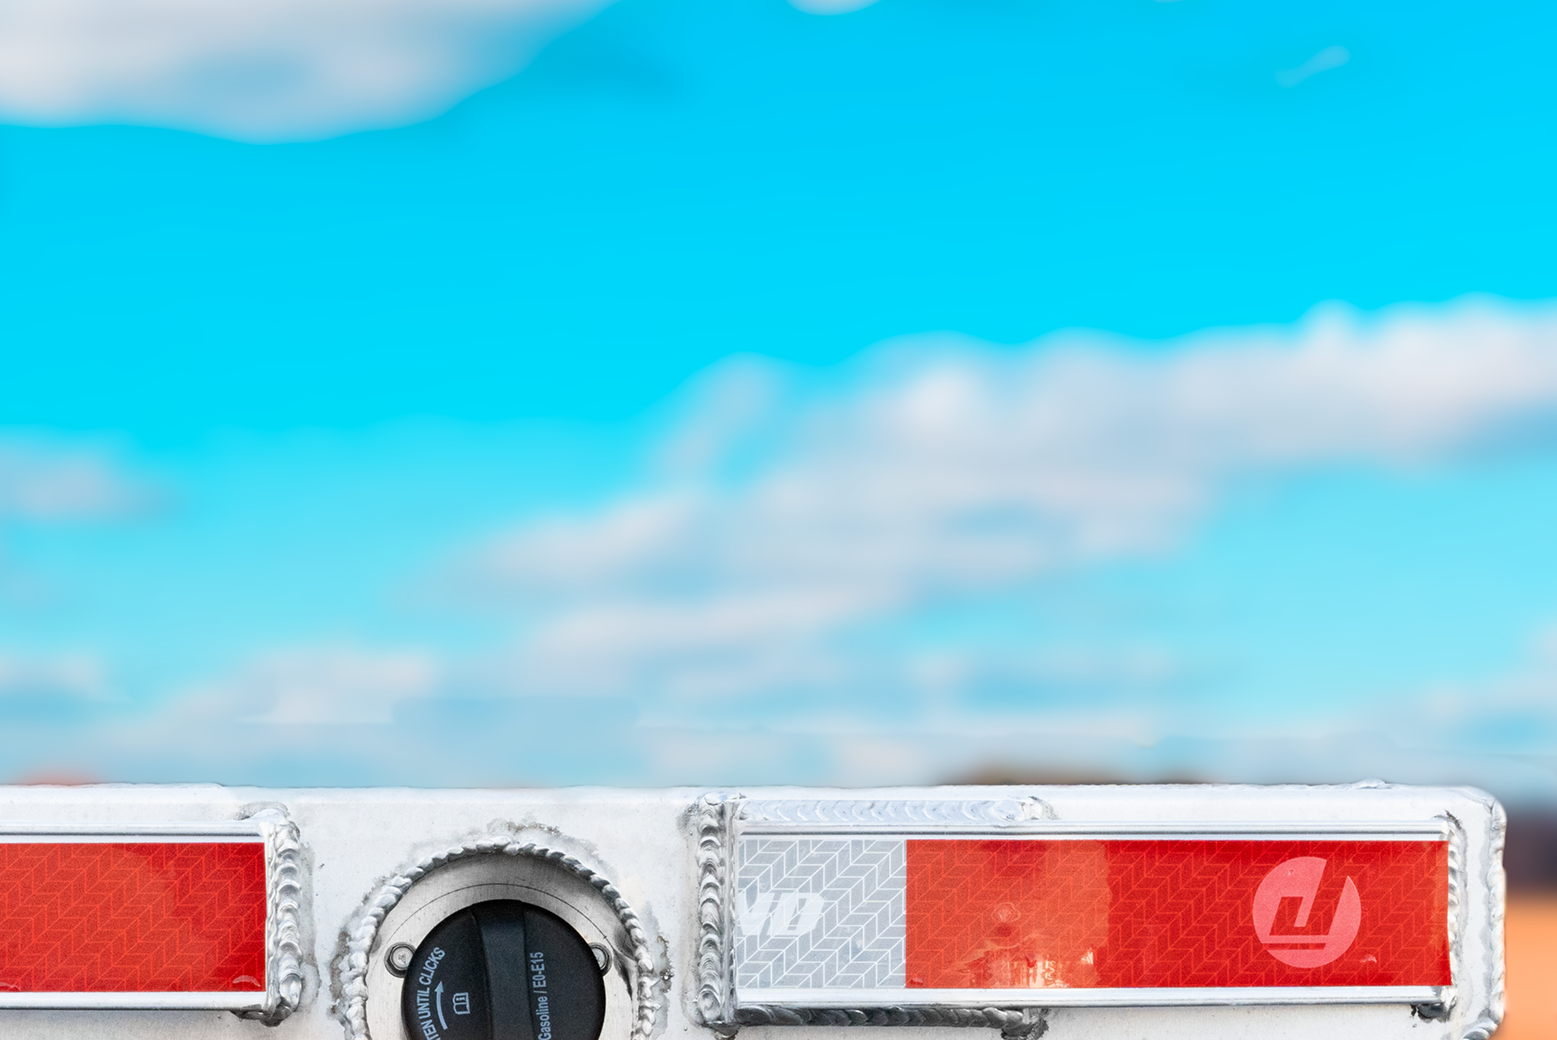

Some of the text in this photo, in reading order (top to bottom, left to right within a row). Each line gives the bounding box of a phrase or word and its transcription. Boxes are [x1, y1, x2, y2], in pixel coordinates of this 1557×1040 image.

[418, 946, 446, 986] CLICKS
[529, 951, 547, 989] E0-E15
[417, 986, 432, 1019] UNTIL
[536, 995, 552, 1040] Gasoline
